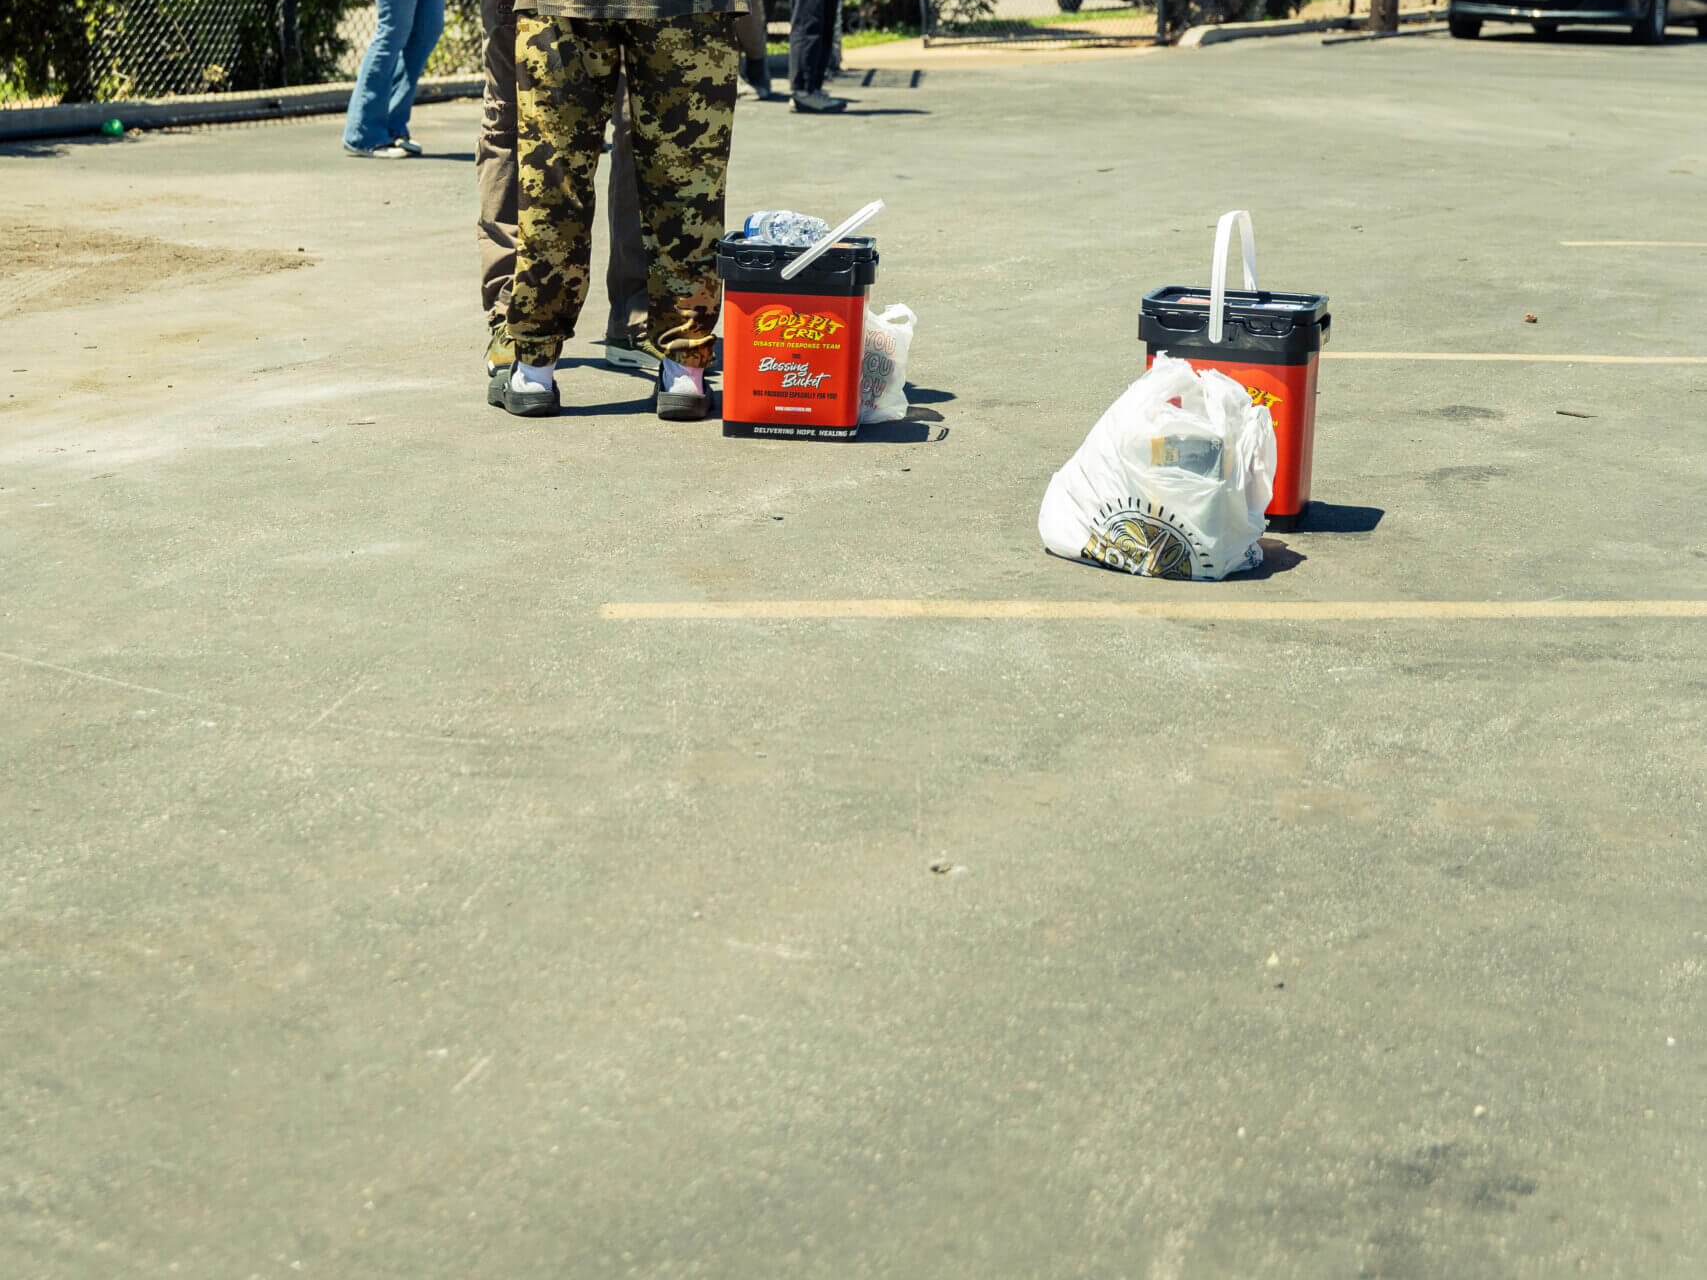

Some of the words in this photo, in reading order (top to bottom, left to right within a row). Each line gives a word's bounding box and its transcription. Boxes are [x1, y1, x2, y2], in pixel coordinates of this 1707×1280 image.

[753, 340, 785, 348] DISASTER
[865, 328, 897, 355] YOU
[758, 356, 810, 377] Blessing
[781, 372, 833, 390] Bucket
[753, 426, 794, 435] DELIVERING
